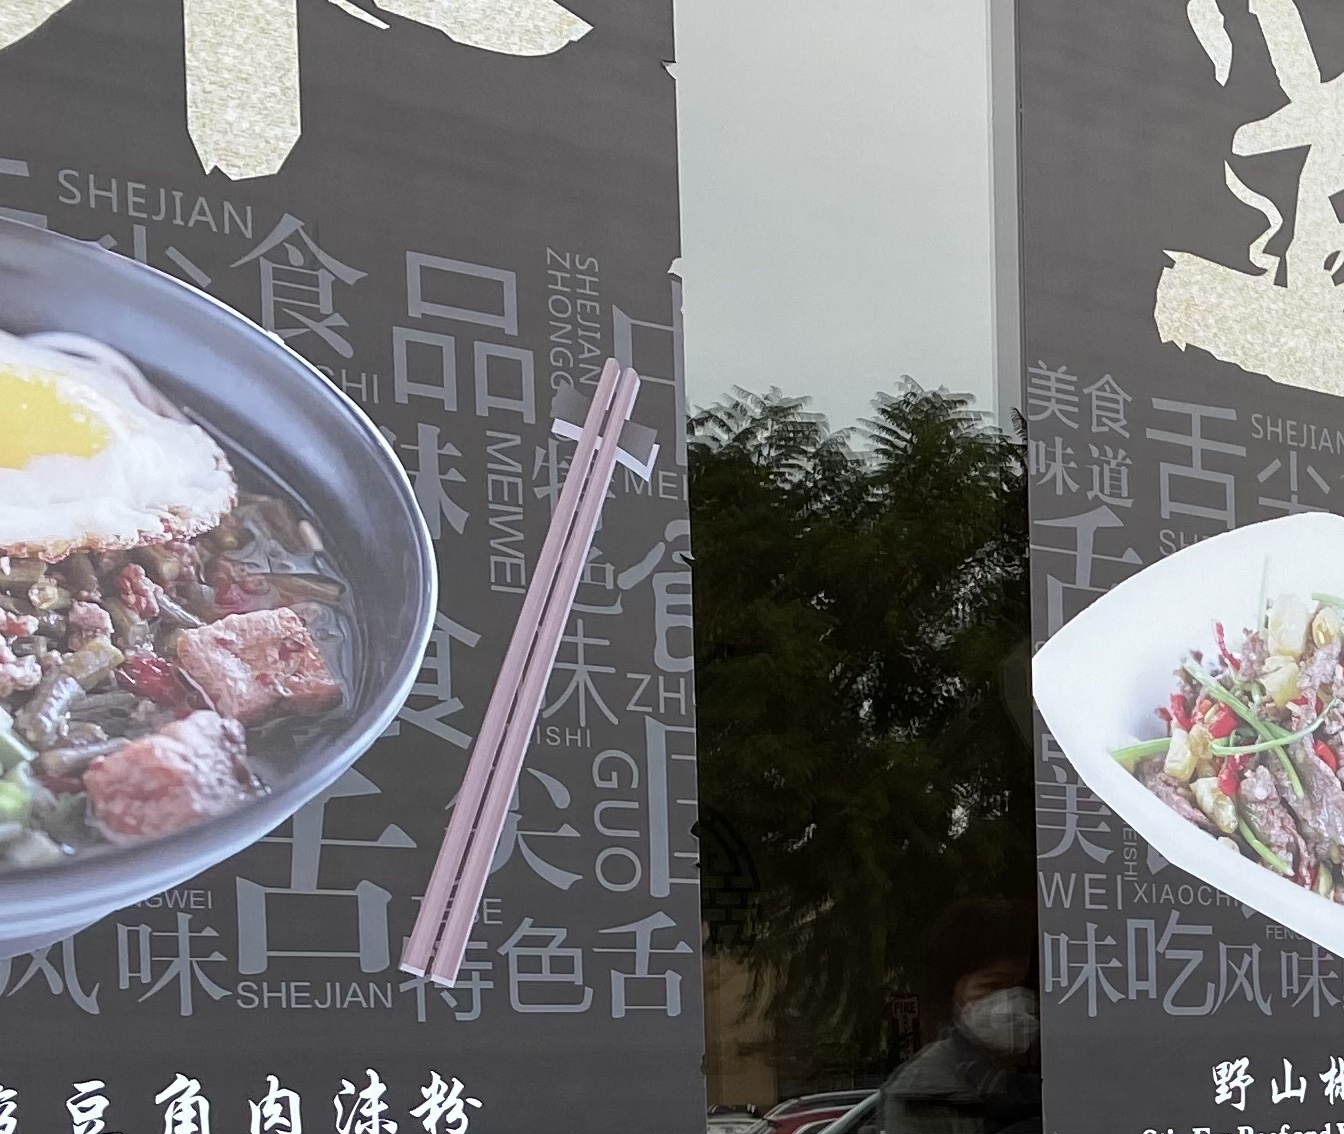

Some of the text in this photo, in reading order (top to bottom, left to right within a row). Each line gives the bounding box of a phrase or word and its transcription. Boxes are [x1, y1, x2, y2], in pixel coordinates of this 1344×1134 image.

[57, 168, 253, 239] SHEJIAN
[1027, 359, 1133, 438] 美食
[1027, 436, 1135, 508] 味道
[486, 430, 527, 595] MEIWEI
[592, 749, 643, 892] GUO
[1038, 872, 1124, 911] WEI
[236, 981, 393, 1010] SHEJIAN
